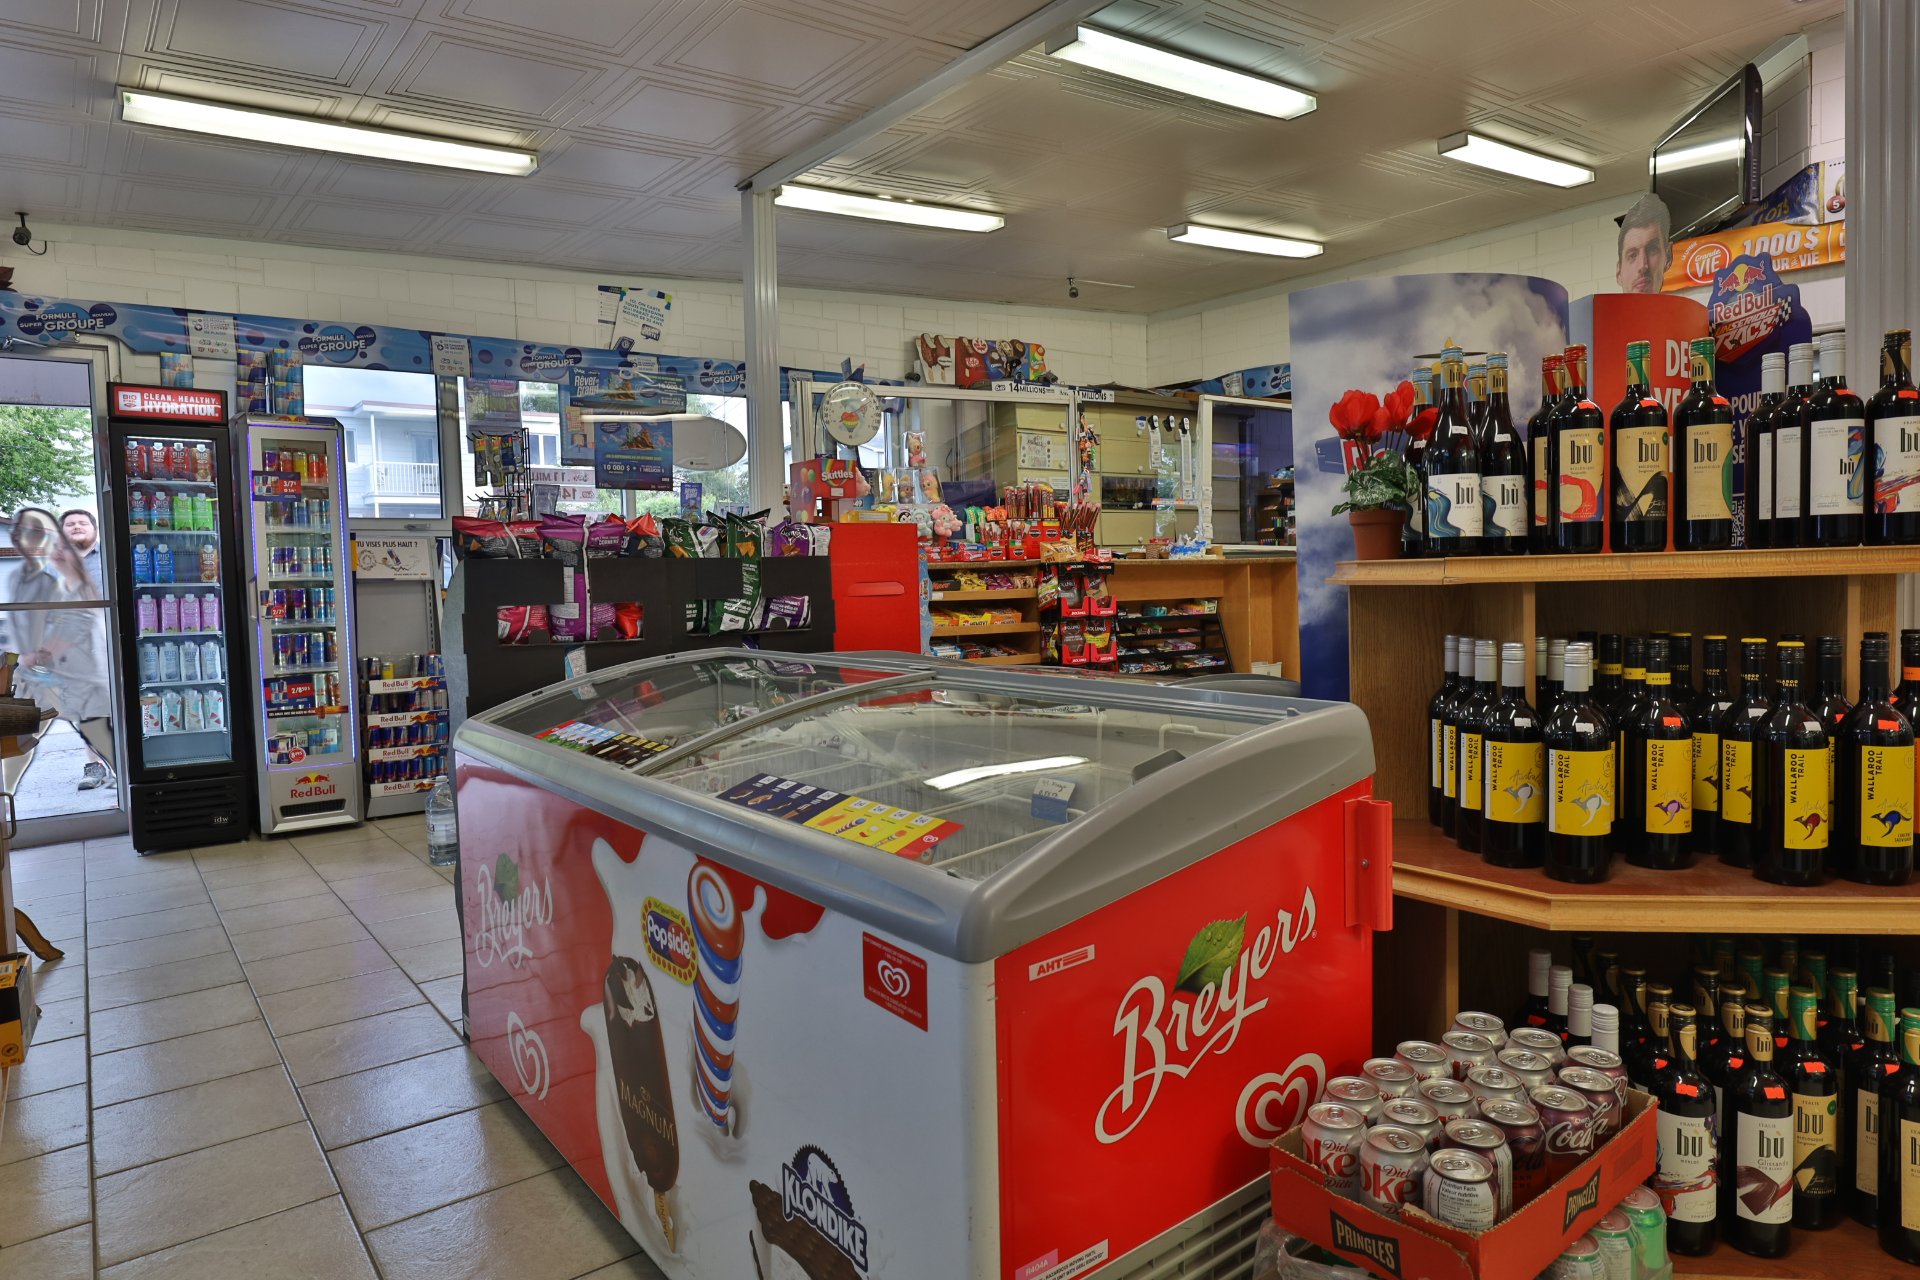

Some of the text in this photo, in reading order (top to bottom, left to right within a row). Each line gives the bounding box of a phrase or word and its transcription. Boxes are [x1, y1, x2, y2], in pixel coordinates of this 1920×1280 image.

[1832, 200, 1840, 209] 5
[1694, 248, 1722, 262] Grande
[1799, 254, 1820, 266] VIE
[1694, 256, 1722, 278] VIE
[1713, 284, 1773, 325] Red Bull
[36, 312, 77, 321] FORMULE
[44, 318, 105, 331] GROUPE
[1715, 307, 1779, 337] UNSERIOUS
[312, 334, 345, 343] FORMULE
[1714, 318, 1776, 352] RACE
[319, 339, 366, 352] GROUPE
[537, 359, 575, 370] GROUPE
[713, 373, 745, 384] GROUPE
[1008, 382, 1046, 395] 14 MILLIONS
[1081, 391, 1107, 400] MILLIONS
[143, 392, 175, 402] CLEAN.
[178, 395, 219, 405] HEALTHY.
[143, 400, 219, 417] HYDRATION.
[821, 469, 854, 481] Skittles
[1657, 744, 1665, 768] TRAIL
[1875, 751, 1883, 775] TRAIL
[1790, 753, 1798, 804] WALLAROO
[1867, 750, 1875, 800] WALLAROO
[290, 784, 336, 798] Red Bull
[475, 862, 554, 969] Breyers
[647, 914, 691, 960] Popsicle
[1036, 957, 1064, 977] AHT
[1093, 885, 1318, 1145] Breyers
[619, 1078, 676, 1146] MAGNUM
[1323, 1139, 1349, 1152] Diet
[1676, 1128, 1704, 1157] bù
[1758, 1130, 1785, 1158] bù
[1382, 1164, 1411, 1179] Diet
[1463, 1184, 1477, 1192] Facts
[1565, 1174, 1599, 1225] PRINGLES
[782, 1163, 867, 1268] KLONDIKE
[1334, 1218, 1397, 1272] PRINGLES
[1025, 1259, 1049, 1277] R404A
